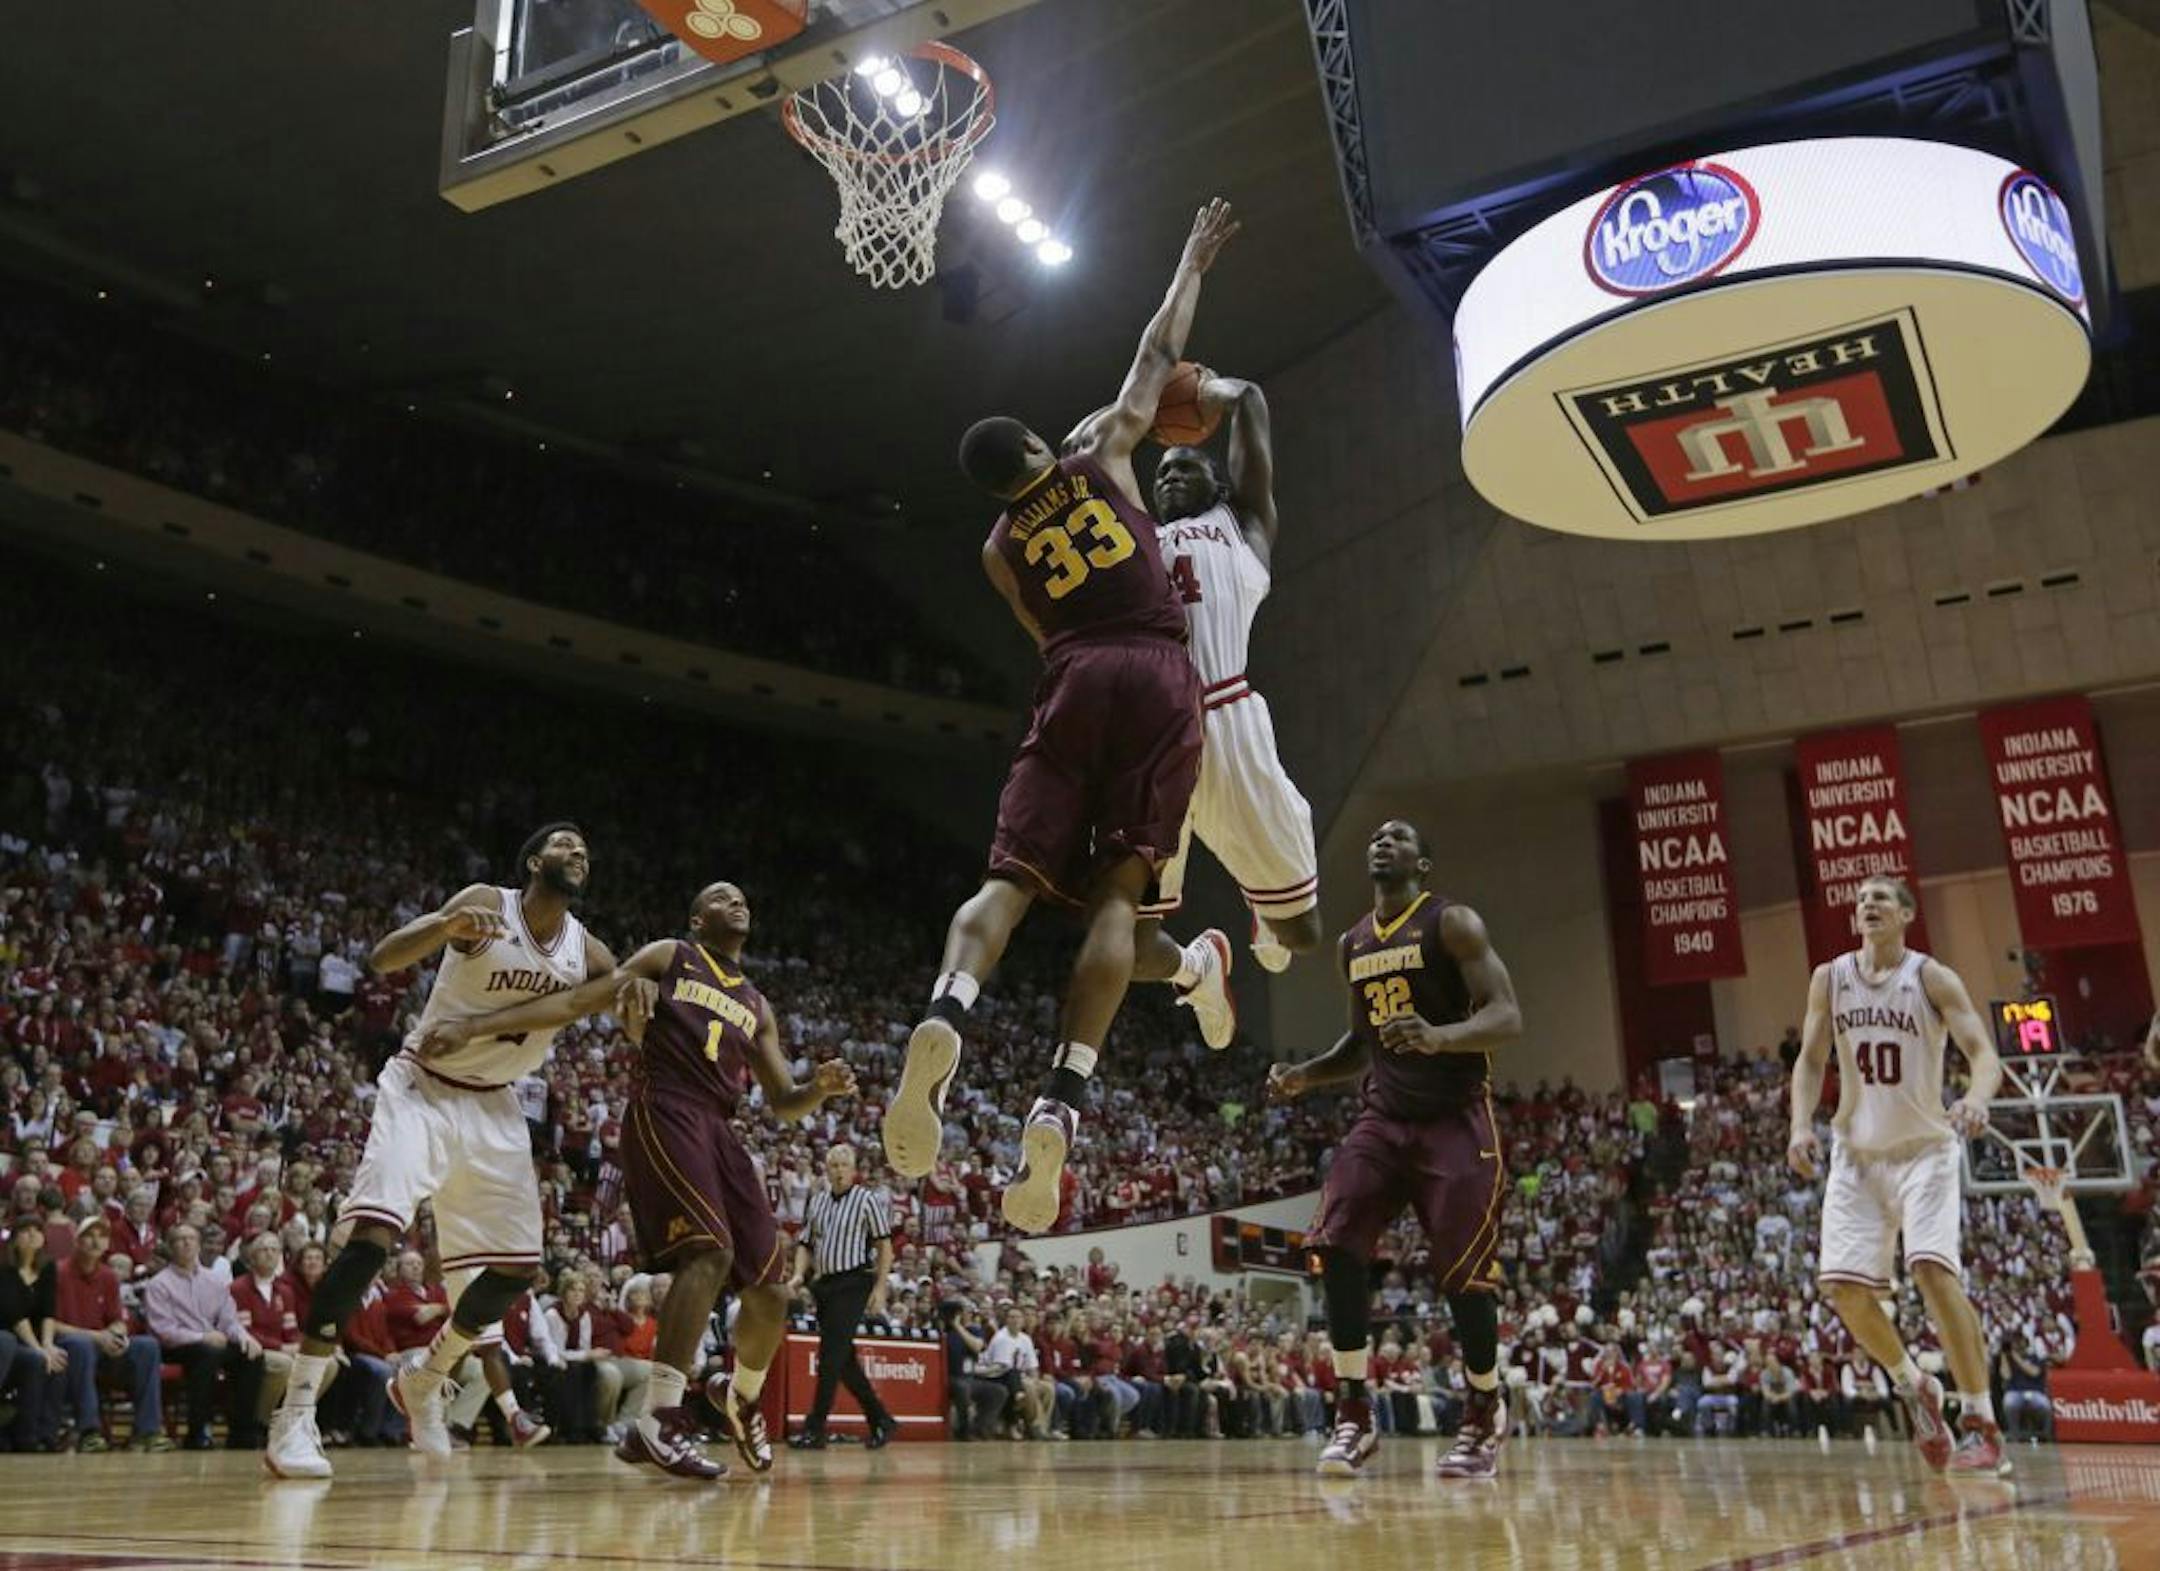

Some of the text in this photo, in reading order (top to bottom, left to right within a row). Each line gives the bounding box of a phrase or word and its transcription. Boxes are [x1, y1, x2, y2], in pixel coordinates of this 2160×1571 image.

[1602, 190, 1742, 276] Kroger
[2012, 184, 2076, 289] Krog
[1601, 335, 1879, 417] HEALTH
[1009, 482, 1070, 541] WILLIAMS
[1025, 498, 1136, 600] 33
[1168, 554, 1202, 603] 4
[2004, 727, 2079, 757] INDIANA
[1816, 755, 1884, 782] INDIANA
[1997, 751, 2094, 783] UNIVERSITY
[1644, 780, 1707, 805] INDIANA
[1809, 778, 1895, 808] UNIVERSITY
[2000, 783, 2108, 828] NCAA
[1637, 802, 1718, 831] UNIVERSITY
[1811, 809, 1906, 850] NCAA
[1639, 832, 1727, 871] NCAA
[2010, 828, 2110, 860] BASKETBALL
[1818, 851, 1908, 881] BASKETBALL
[2020, 855, 2113, 886] CHAMPIONS
[1645, 873, 1728, 902] BASKETBALL
[2052, 890, 2098, 916] 1976
[1650, 898, 1728, 926] CHAMPIONS
[1673, 931, 1714, 954] 1940
[484, 970, 573, 994] INDIAN
[1364, 976, 1414, 1026] 32
[1835, 1007, 1919, 1037] INDIANA
[704, 1020, 722, 1062] 1
[1856, 1041, 1901, 1085] 40
[862, 1354, 926, 1384] University
[2053, 1397, 2158, 1423] Smithville
